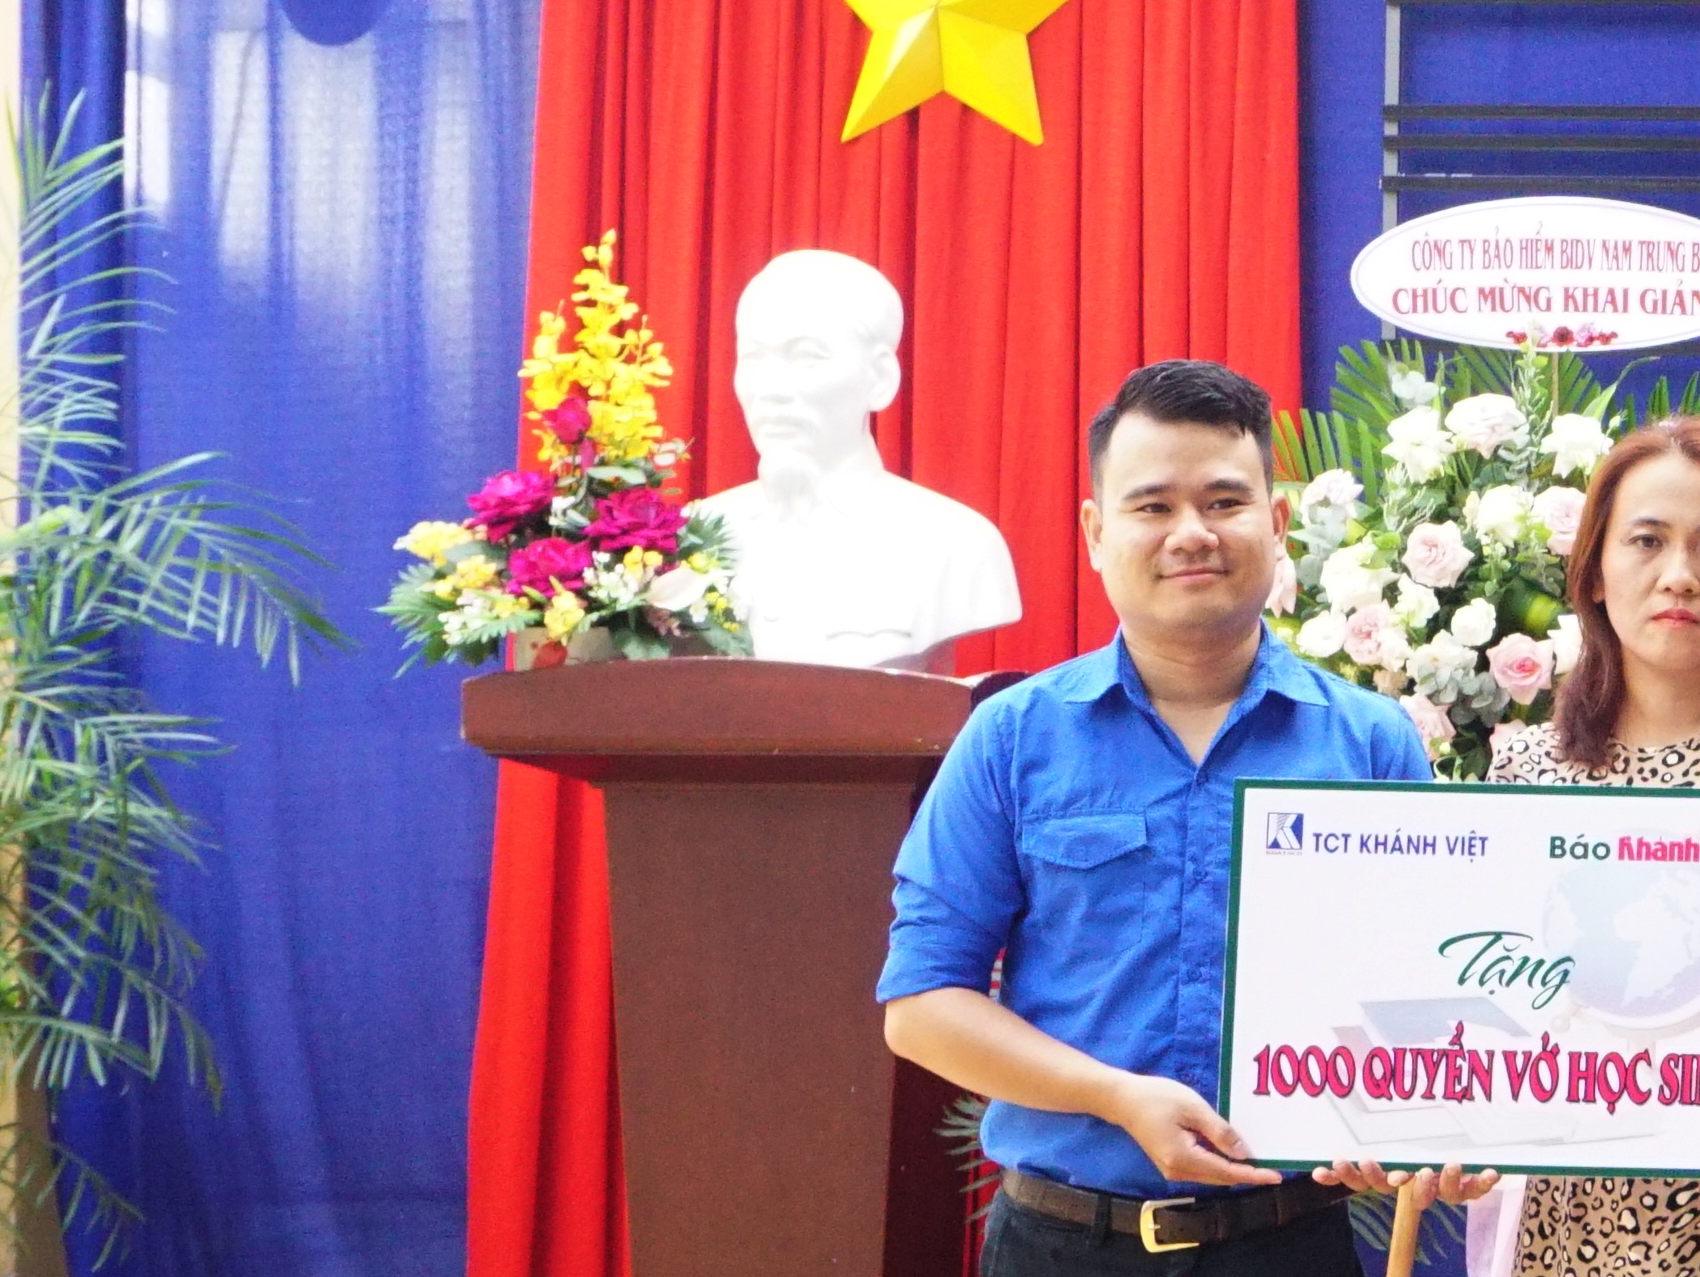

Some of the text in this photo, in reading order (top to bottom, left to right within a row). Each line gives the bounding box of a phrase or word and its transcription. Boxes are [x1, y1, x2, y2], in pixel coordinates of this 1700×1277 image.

[1412, 233, 1452, 271] CÔNG
[1459, 239, 1476, 270] TY
[1482, 226, 1513, 270] BẢO
[1519, 222, 1554, 270] HIỂM
[1560, 239, 1595, 270] BIDV
[1601, 240, 1632, 271] NAM
[1638, 241, 1685, 273] TRUNG
[1392, 278, 1468, 315] CHÚC
[1477, 278, 1552, 312] MỪNG
[1563, 287, 1629, 313] KHAI
[1313, 829, 1488, 863] TCT KHÁNH VIỆT
[1549, 835, 1611, 860] Báo
[1438, 930, 1576, 1010] Tặng
[1253, 1044, 1355, 1097] 1000
[1363, 1020, 1494, 1102] QUYỂN
[1505, 1031, 1560, 1102] VỞ
[1566, 1051, 1653, 1114] HỌC
